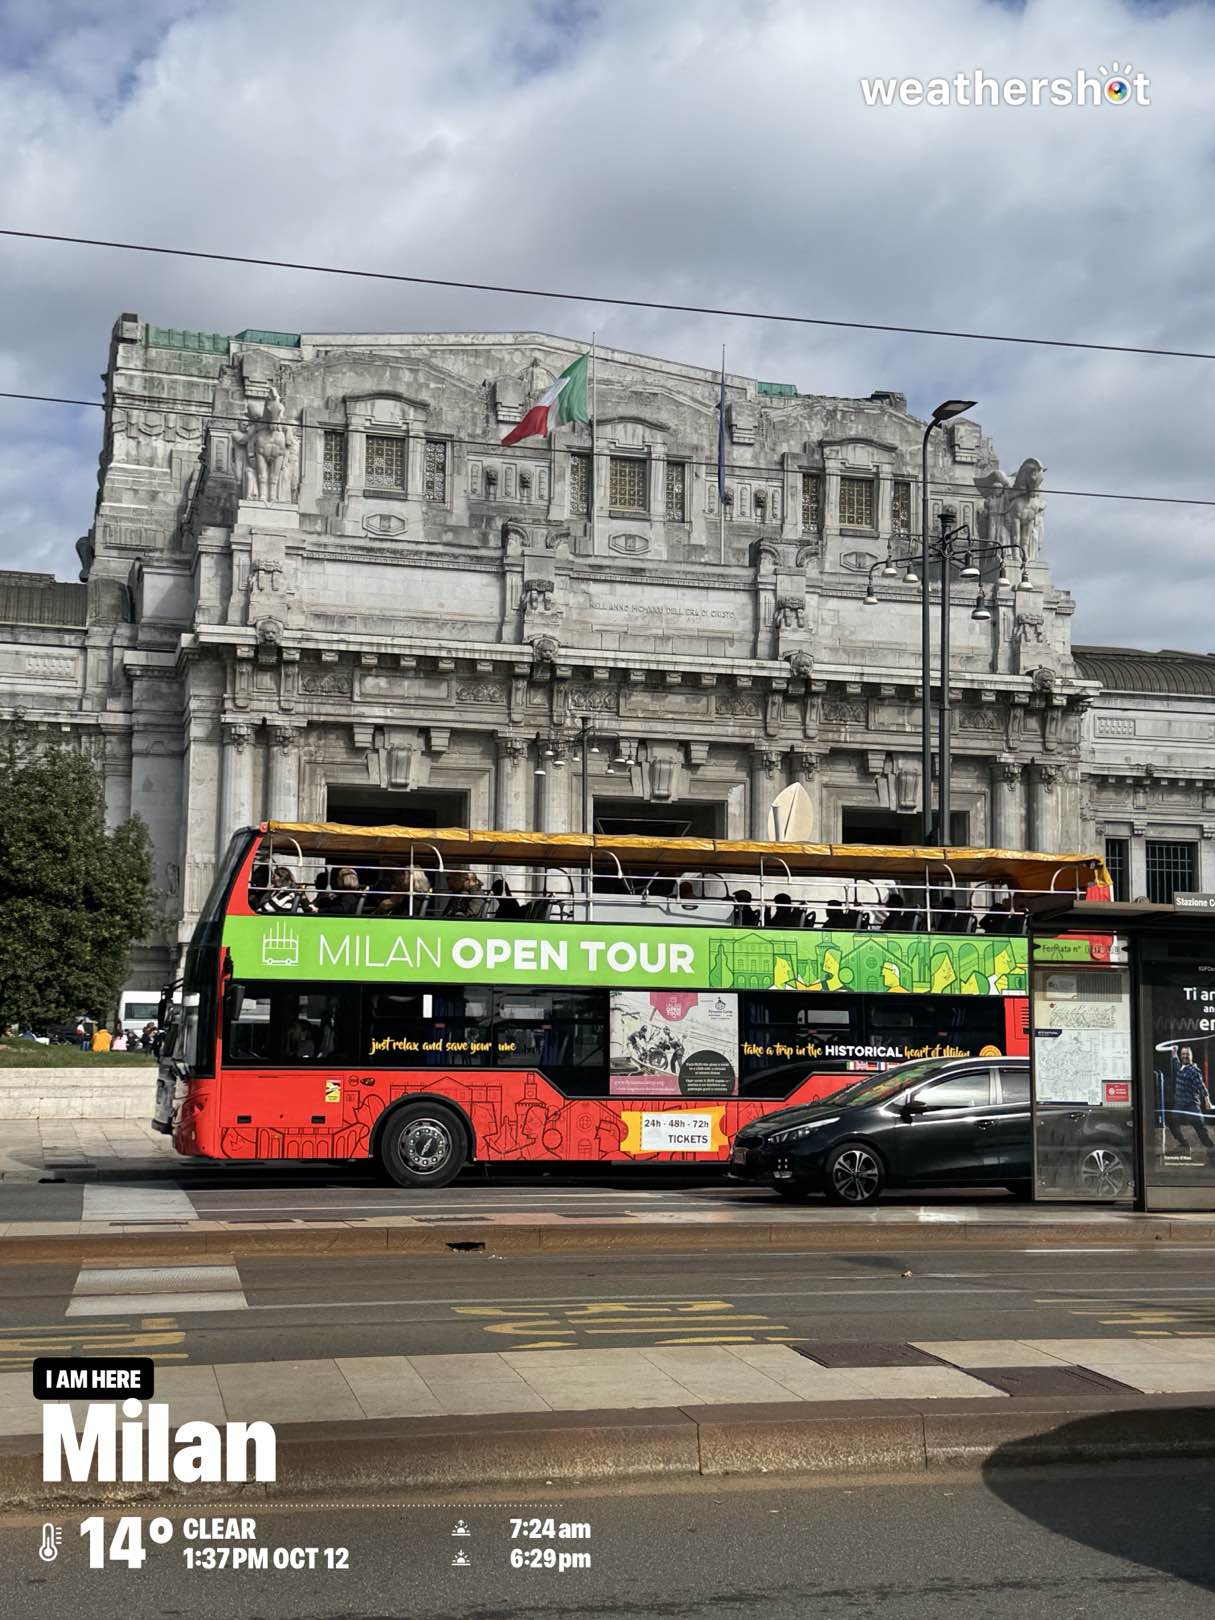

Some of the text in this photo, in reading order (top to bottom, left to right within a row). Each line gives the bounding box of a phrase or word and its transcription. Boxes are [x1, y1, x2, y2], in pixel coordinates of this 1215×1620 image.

[1176, 896, 1208, 907] Stazione
[319, 934, 695, 973] MILAN OPEN TOUR
[1183, 986, 1197, 1001] Ti
[368, 1036, 394, 1055] just
[393, 1037, 419, 1051] relax
[422, 1038, 443, 1051] and
[446, 1042, 468, 1051] save
[470, 1040, 492, 1055] your
[741, 1041, 970, 1060] take a trip in the HISTORICAL heart of Milan
[644, 1119, 661, 1128] 24h
[668, 1119, 685, 1128] 48h
[693, 1119, 709, 1129] 72h
[668, 1134, 709, 1144] TICKETS
